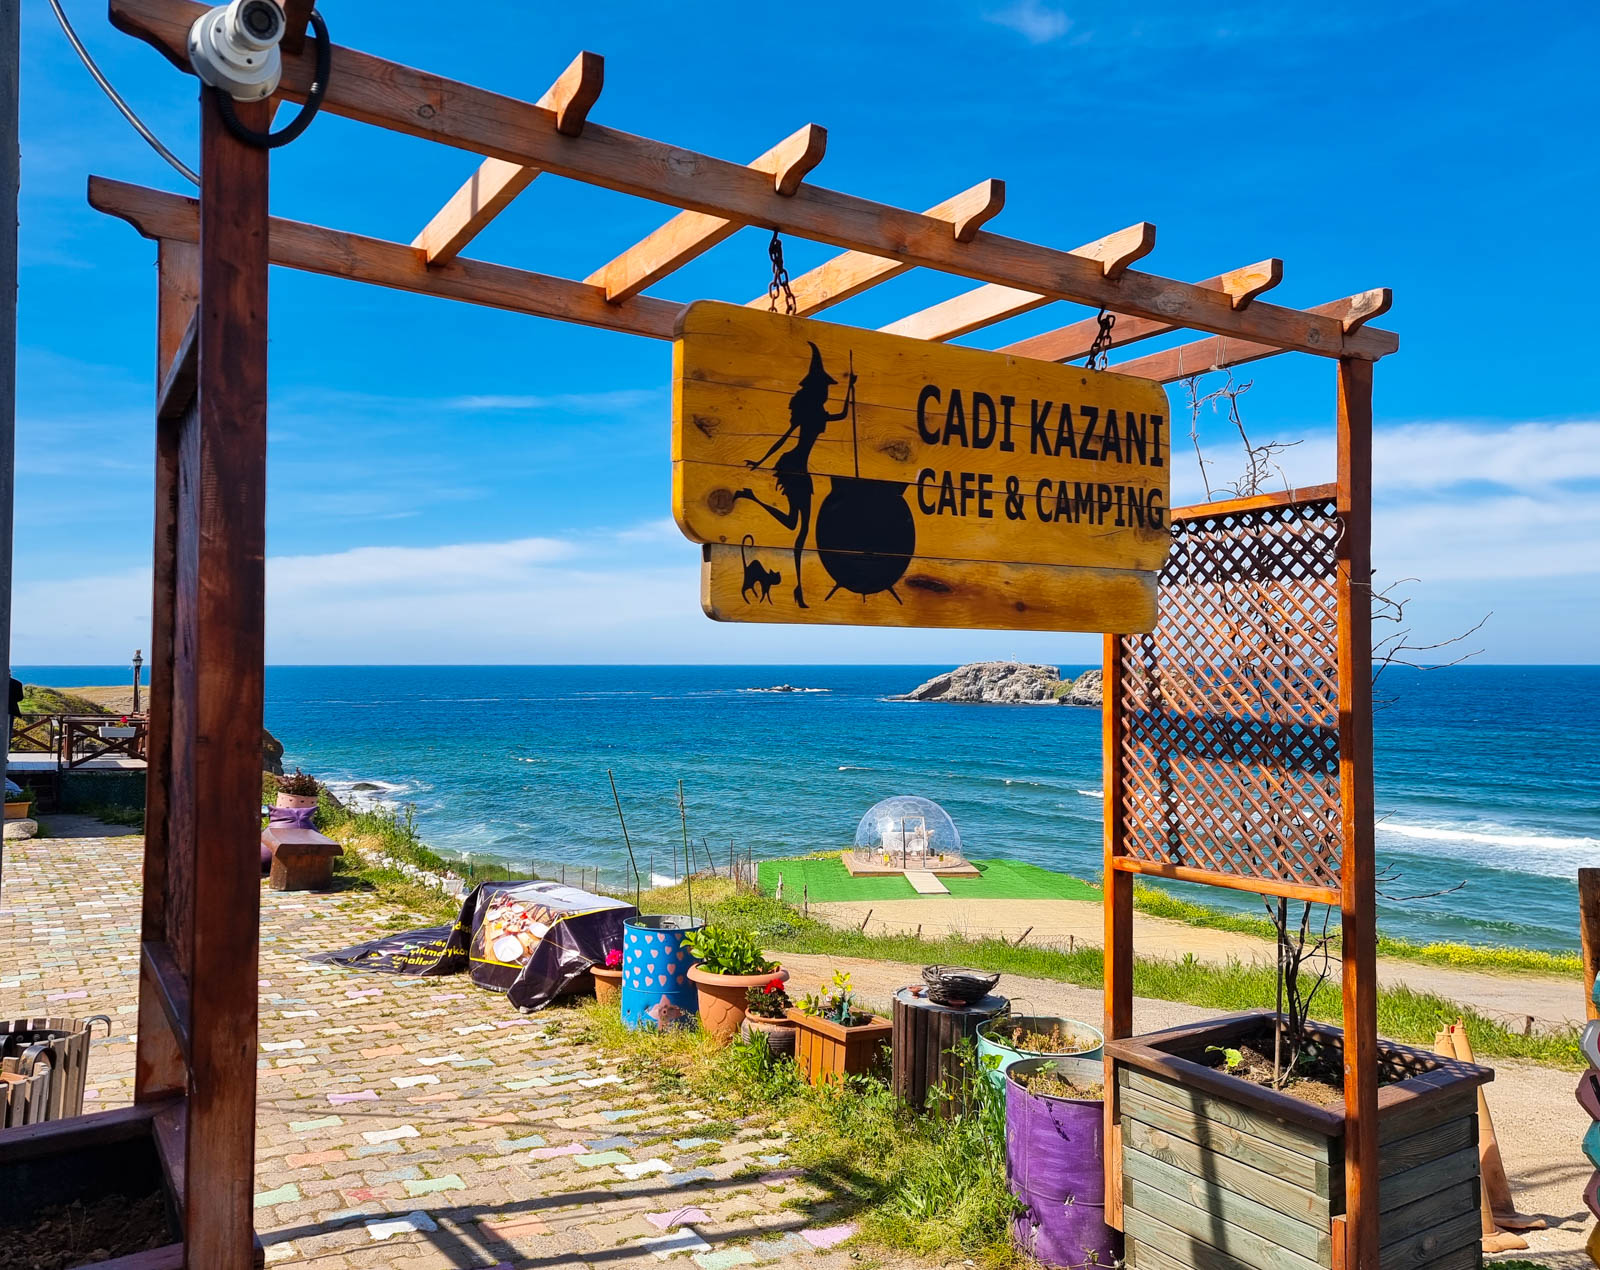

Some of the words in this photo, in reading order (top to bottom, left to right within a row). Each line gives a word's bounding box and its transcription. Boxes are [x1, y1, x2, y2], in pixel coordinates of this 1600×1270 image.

[916, 384, 1016, 453] CADI
[1030, 398, 1164, 468] KAZANI
[916, 467, 995, 519] CAFE
[1005, 475, 1027, 521] &
[1035, 478, 1165, 531] CAMPING
